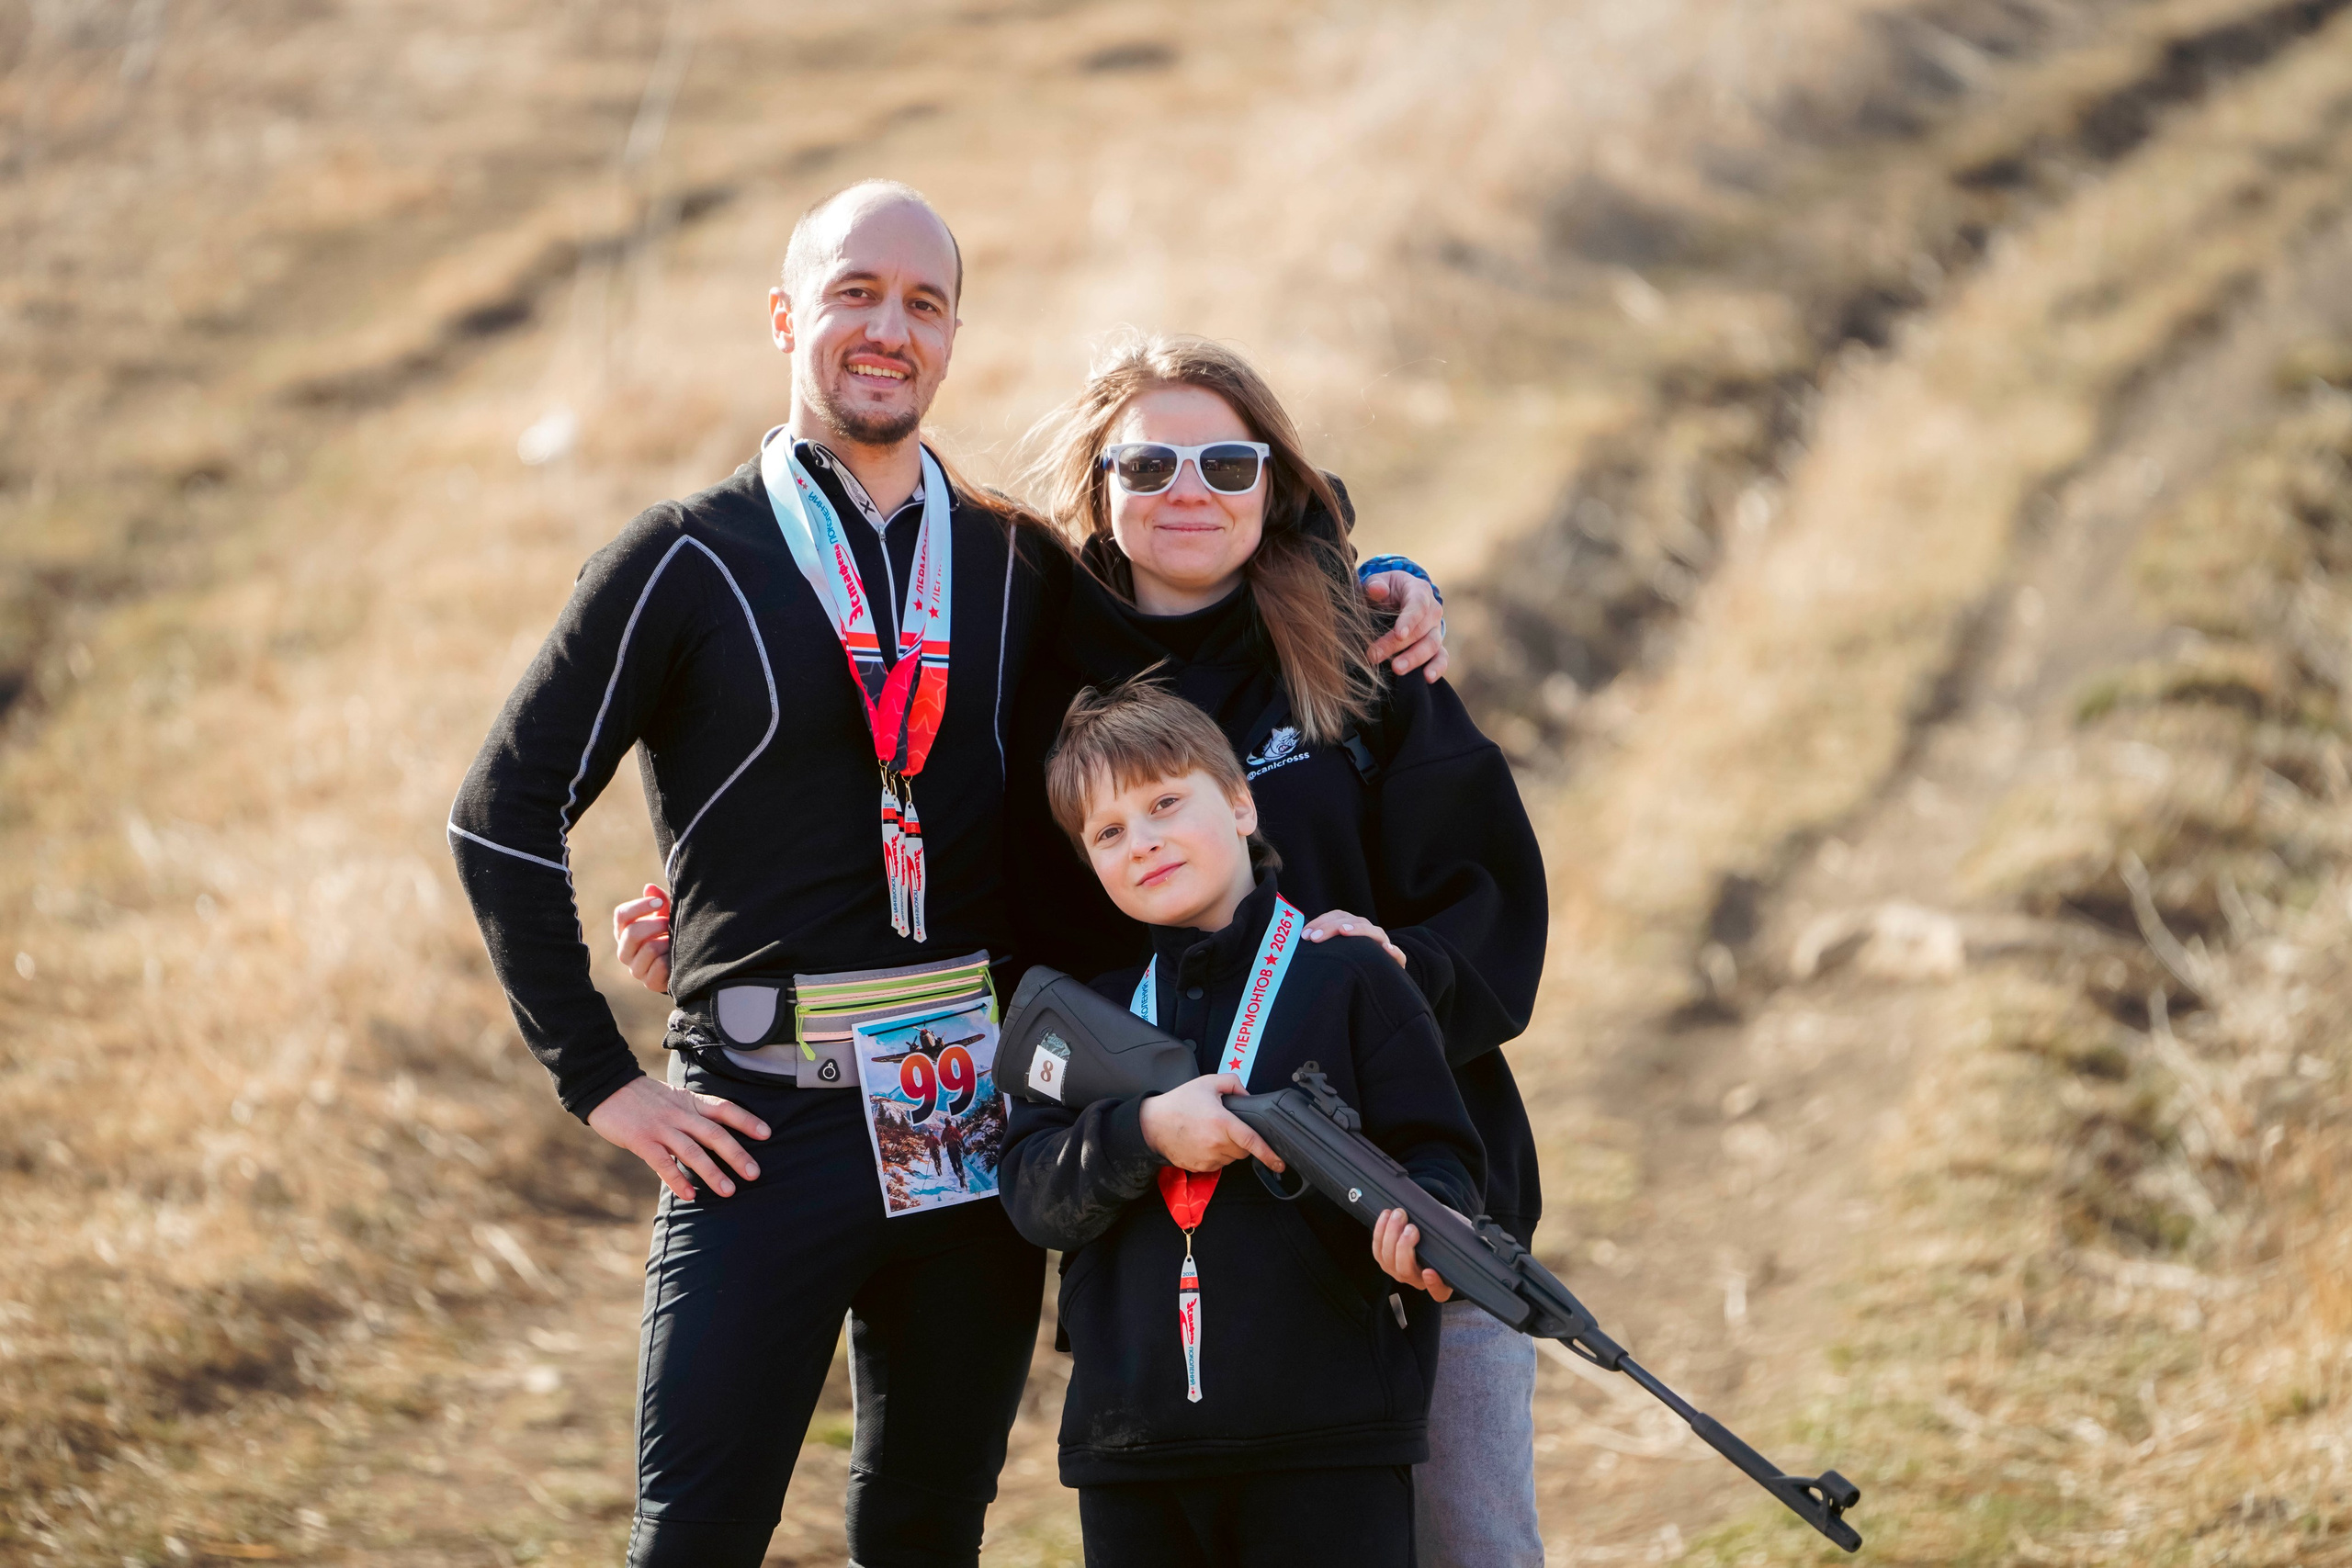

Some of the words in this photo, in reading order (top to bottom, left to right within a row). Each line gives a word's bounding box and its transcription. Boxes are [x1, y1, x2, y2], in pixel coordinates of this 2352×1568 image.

[808, 491, 838, 545] ПОКОЛЕНИЙ
[834, 544, 864, 626] Эстафета
[1234, 968, 1273, 1054] ЛЕРМОНТОВ
[1270, 919, 1293, 953] 2026
[899, 1044, 978, 1126] 99
[1040, 1059, 1054, 1082] 8
